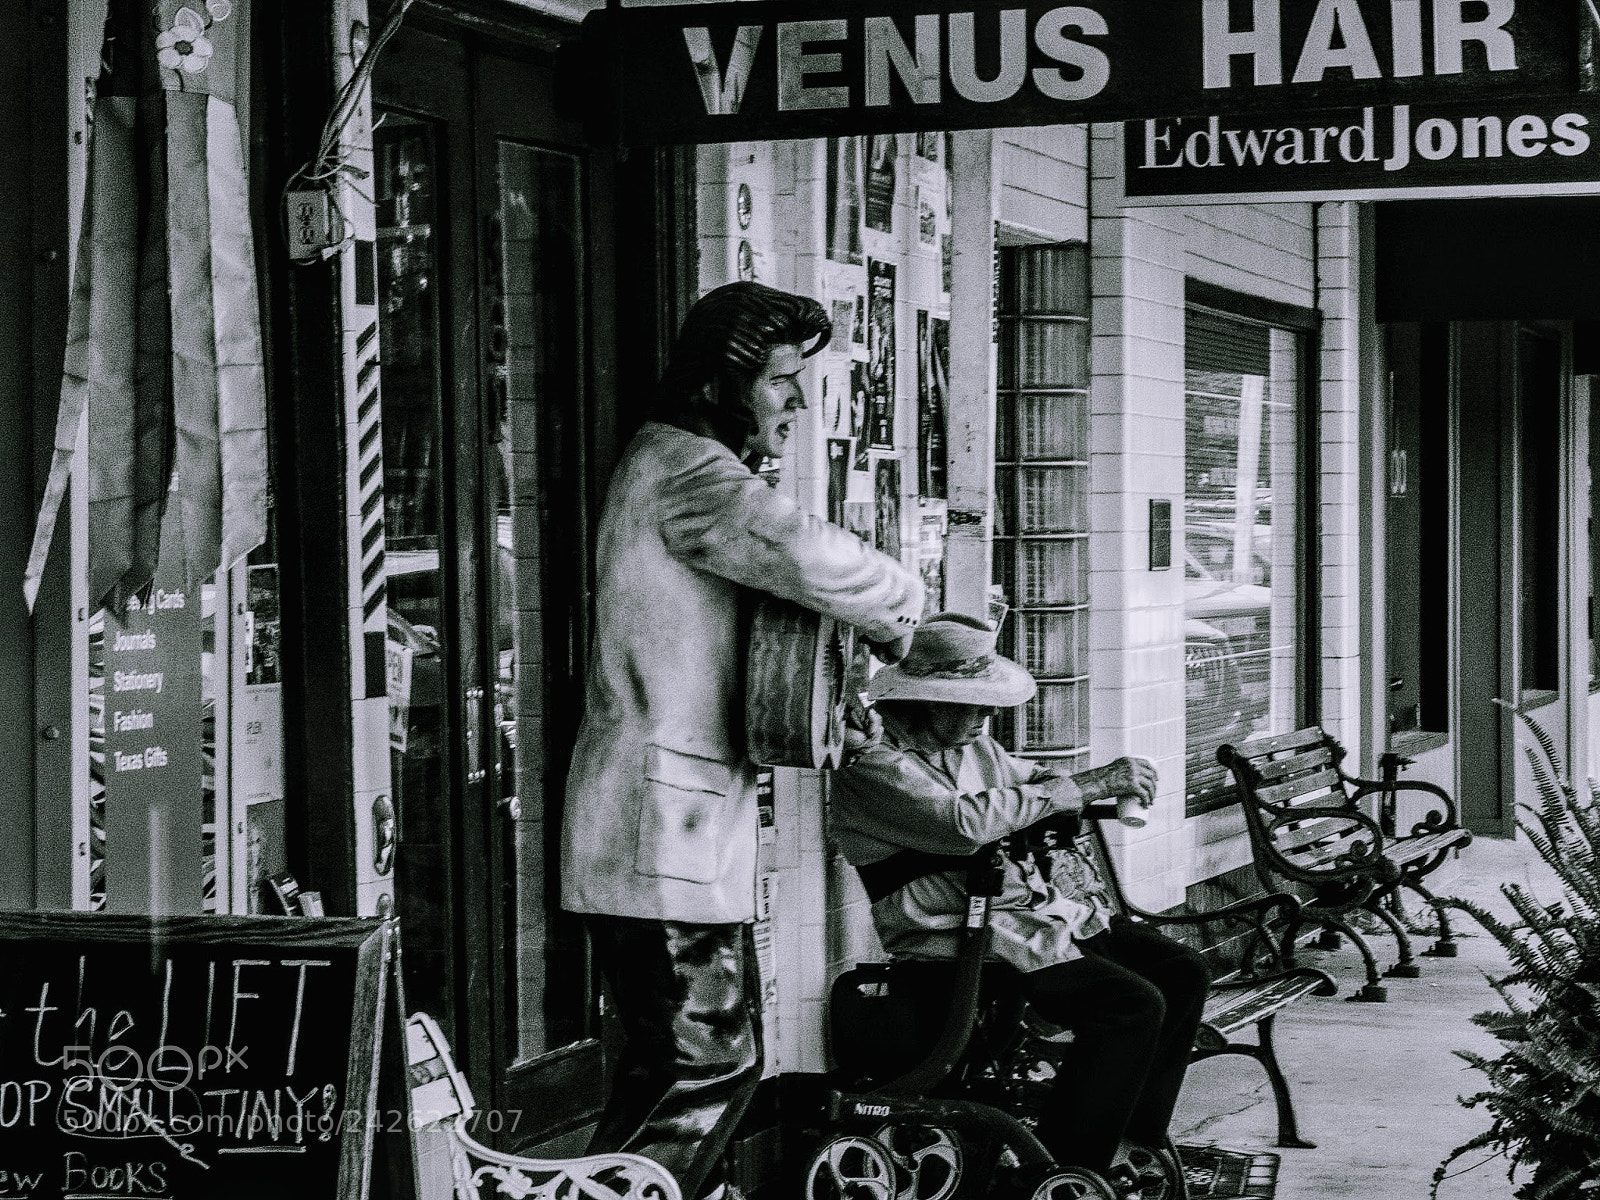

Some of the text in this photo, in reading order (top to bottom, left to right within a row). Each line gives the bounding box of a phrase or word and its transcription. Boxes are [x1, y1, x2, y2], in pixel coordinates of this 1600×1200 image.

[683, 0, 1519, 115] VENUS HAIR
[113, 629, 156, 651] Journals
[113, 670, 163, 693] Stationery
[113, 709, 153, 732] Fashion
[144, 746, 168, 768] Gifts
[25, 955, 332, 1076] the LIFT
[855, 1102, 891, 1117] NITRO
